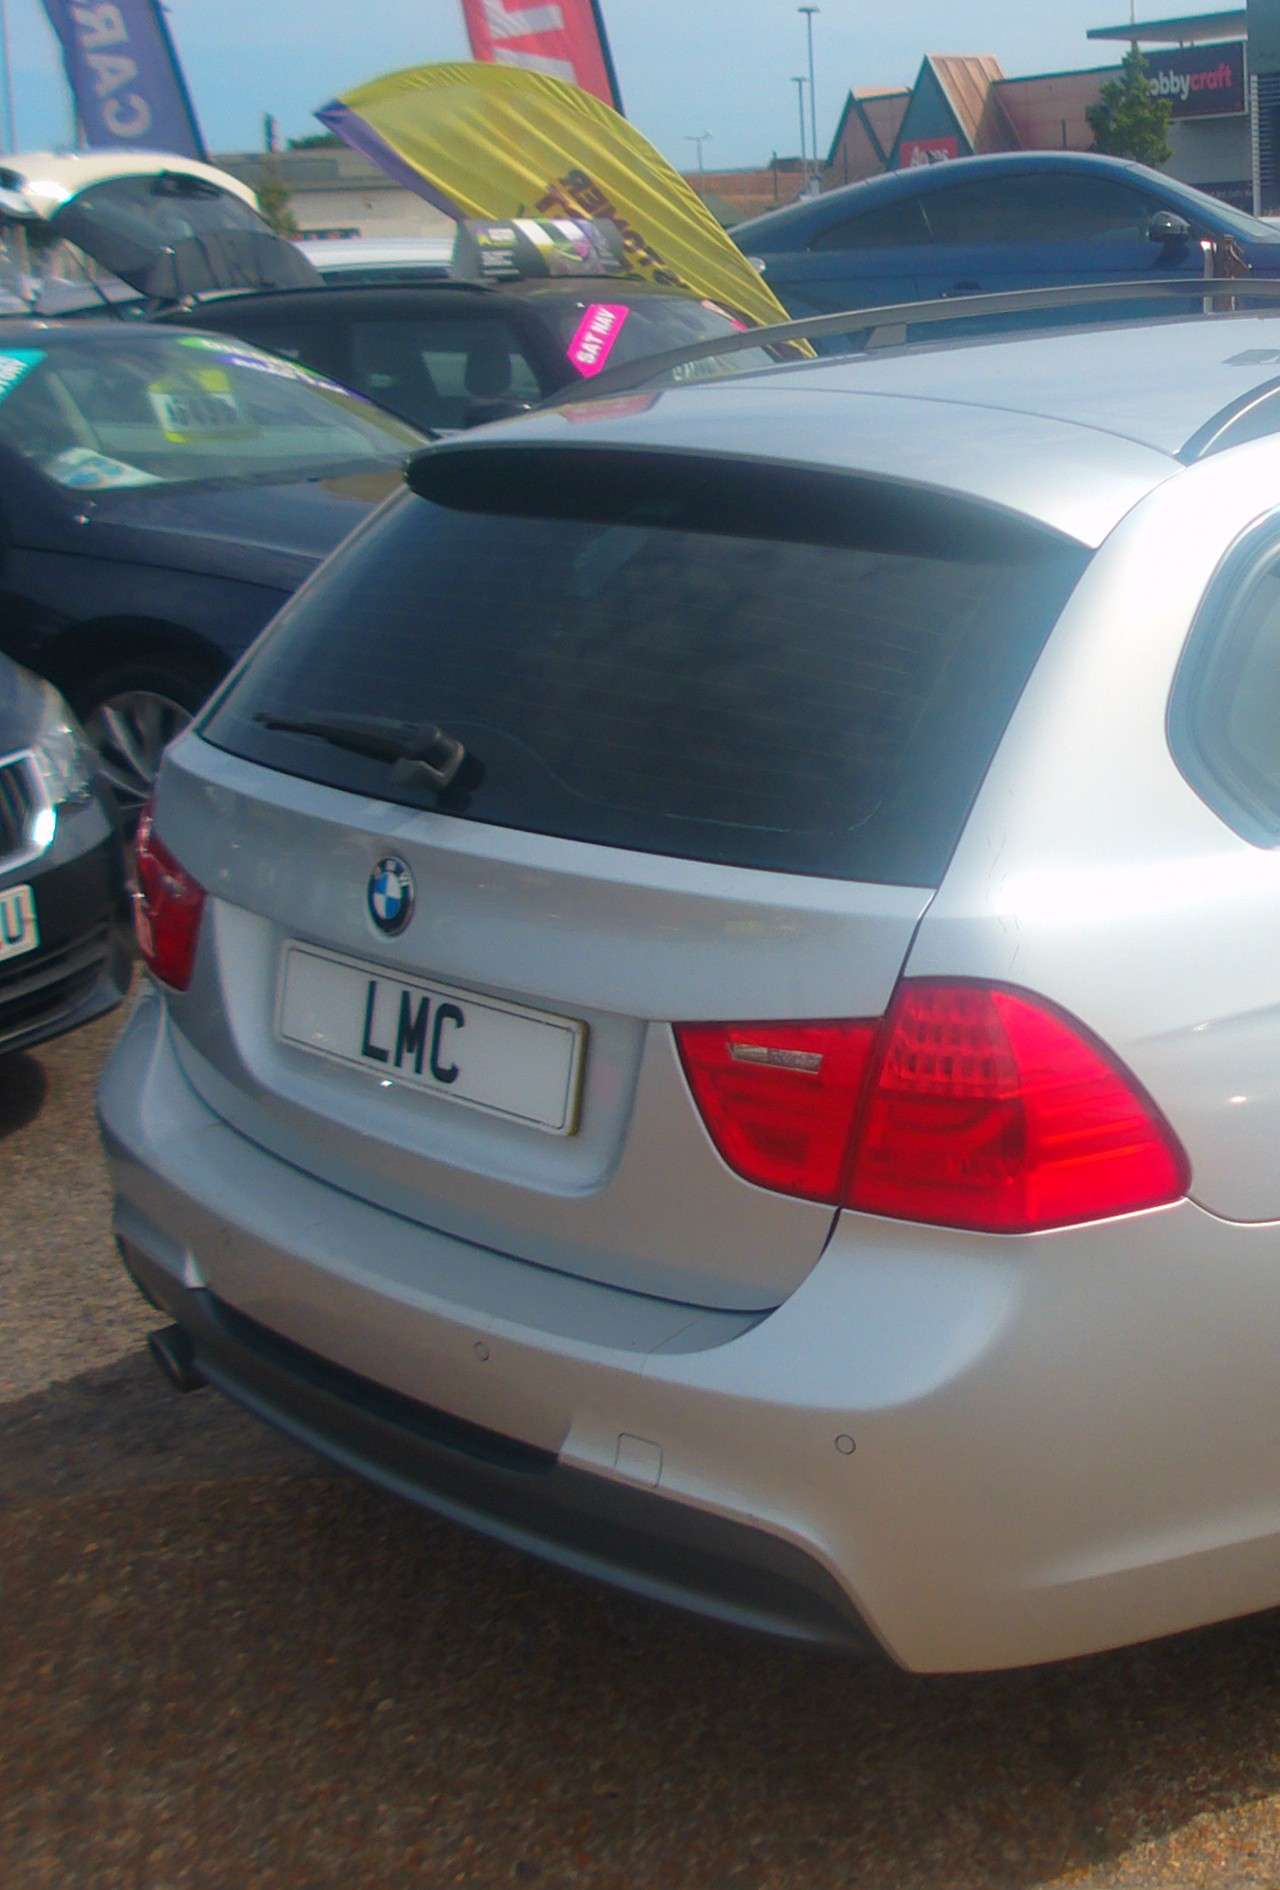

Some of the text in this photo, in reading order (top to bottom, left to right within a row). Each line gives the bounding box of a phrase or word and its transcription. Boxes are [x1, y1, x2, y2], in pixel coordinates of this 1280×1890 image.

[1146, 63, 1233, 101] obbycraft
[575, 307, 615, 364] SAT NAV
[361, 980, 465, 1084] LMC
